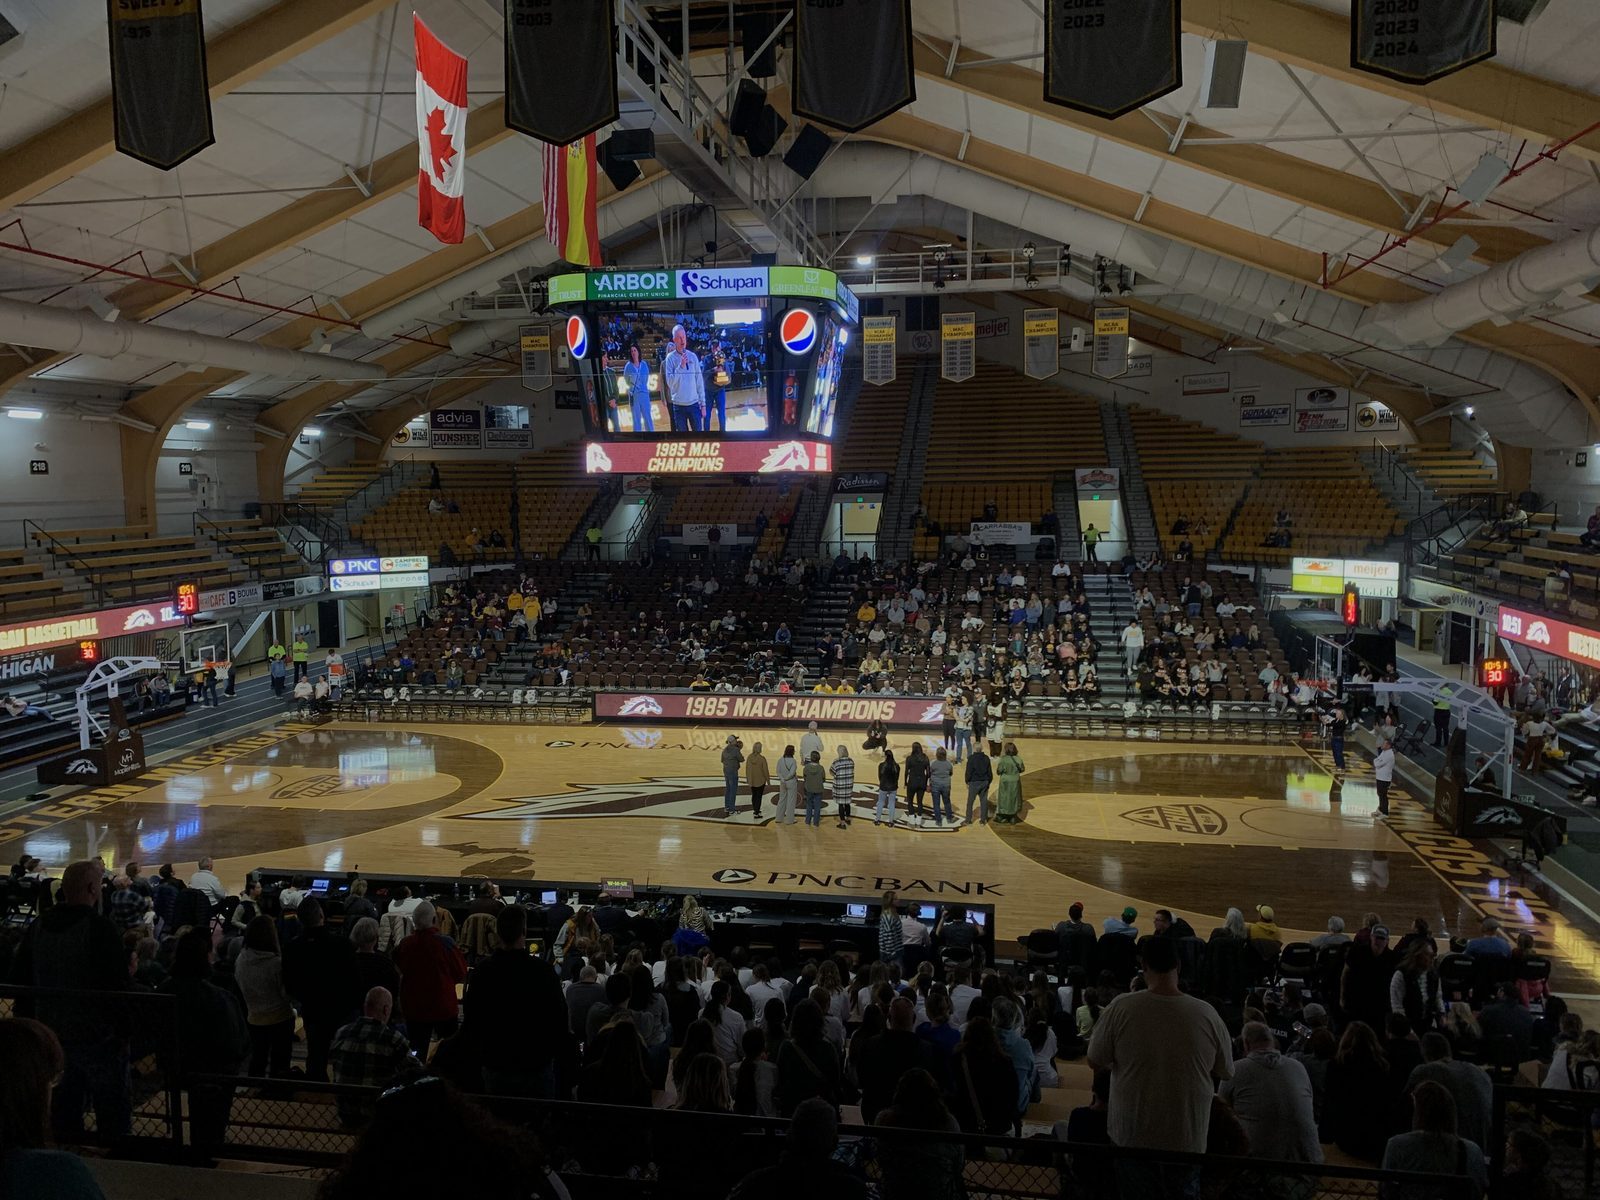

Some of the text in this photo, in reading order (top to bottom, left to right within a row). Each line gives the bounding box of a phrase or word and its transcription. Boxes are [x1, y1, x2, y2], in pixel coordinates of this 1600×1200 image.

[1374, 0, 1419, 15] 2020
[516, 12, 552, 26] 2003
[1063, 13, 1105, 29] 2023
[1374, 18, 1419, 36] 2023
[1373, 39, 1419, 57] 2024
[595, 272, 669, 292] ARBOR
[699, 274, 763, 292] Schupan
[976, 318, 1009, 337] meijer
[436, 411, 474, 424] advia
[433, 433, 480, 442] DUNSHEE
[655, 441, 721, 457] 1985 MAC
[647, 457, 725, 472] CHAMPIONS
[347, 559, 377, 572] PNC
[1354, 564, 1389, 577] meijer
[237, 587, 258, 598] BOUMA
[26, 617, 99, 646] BASKETBALL
[83, 648, 94, 659] 30
[0, 654, 55, 679] HIGAN
[1484, 661, 1508, 671] 10:51
[1487, 670, 1502, 682] 30
[685, 695, 897, 721] 1985 MAC CHAMPIONS
[767, 871, 1005, 897] PNC BANK
